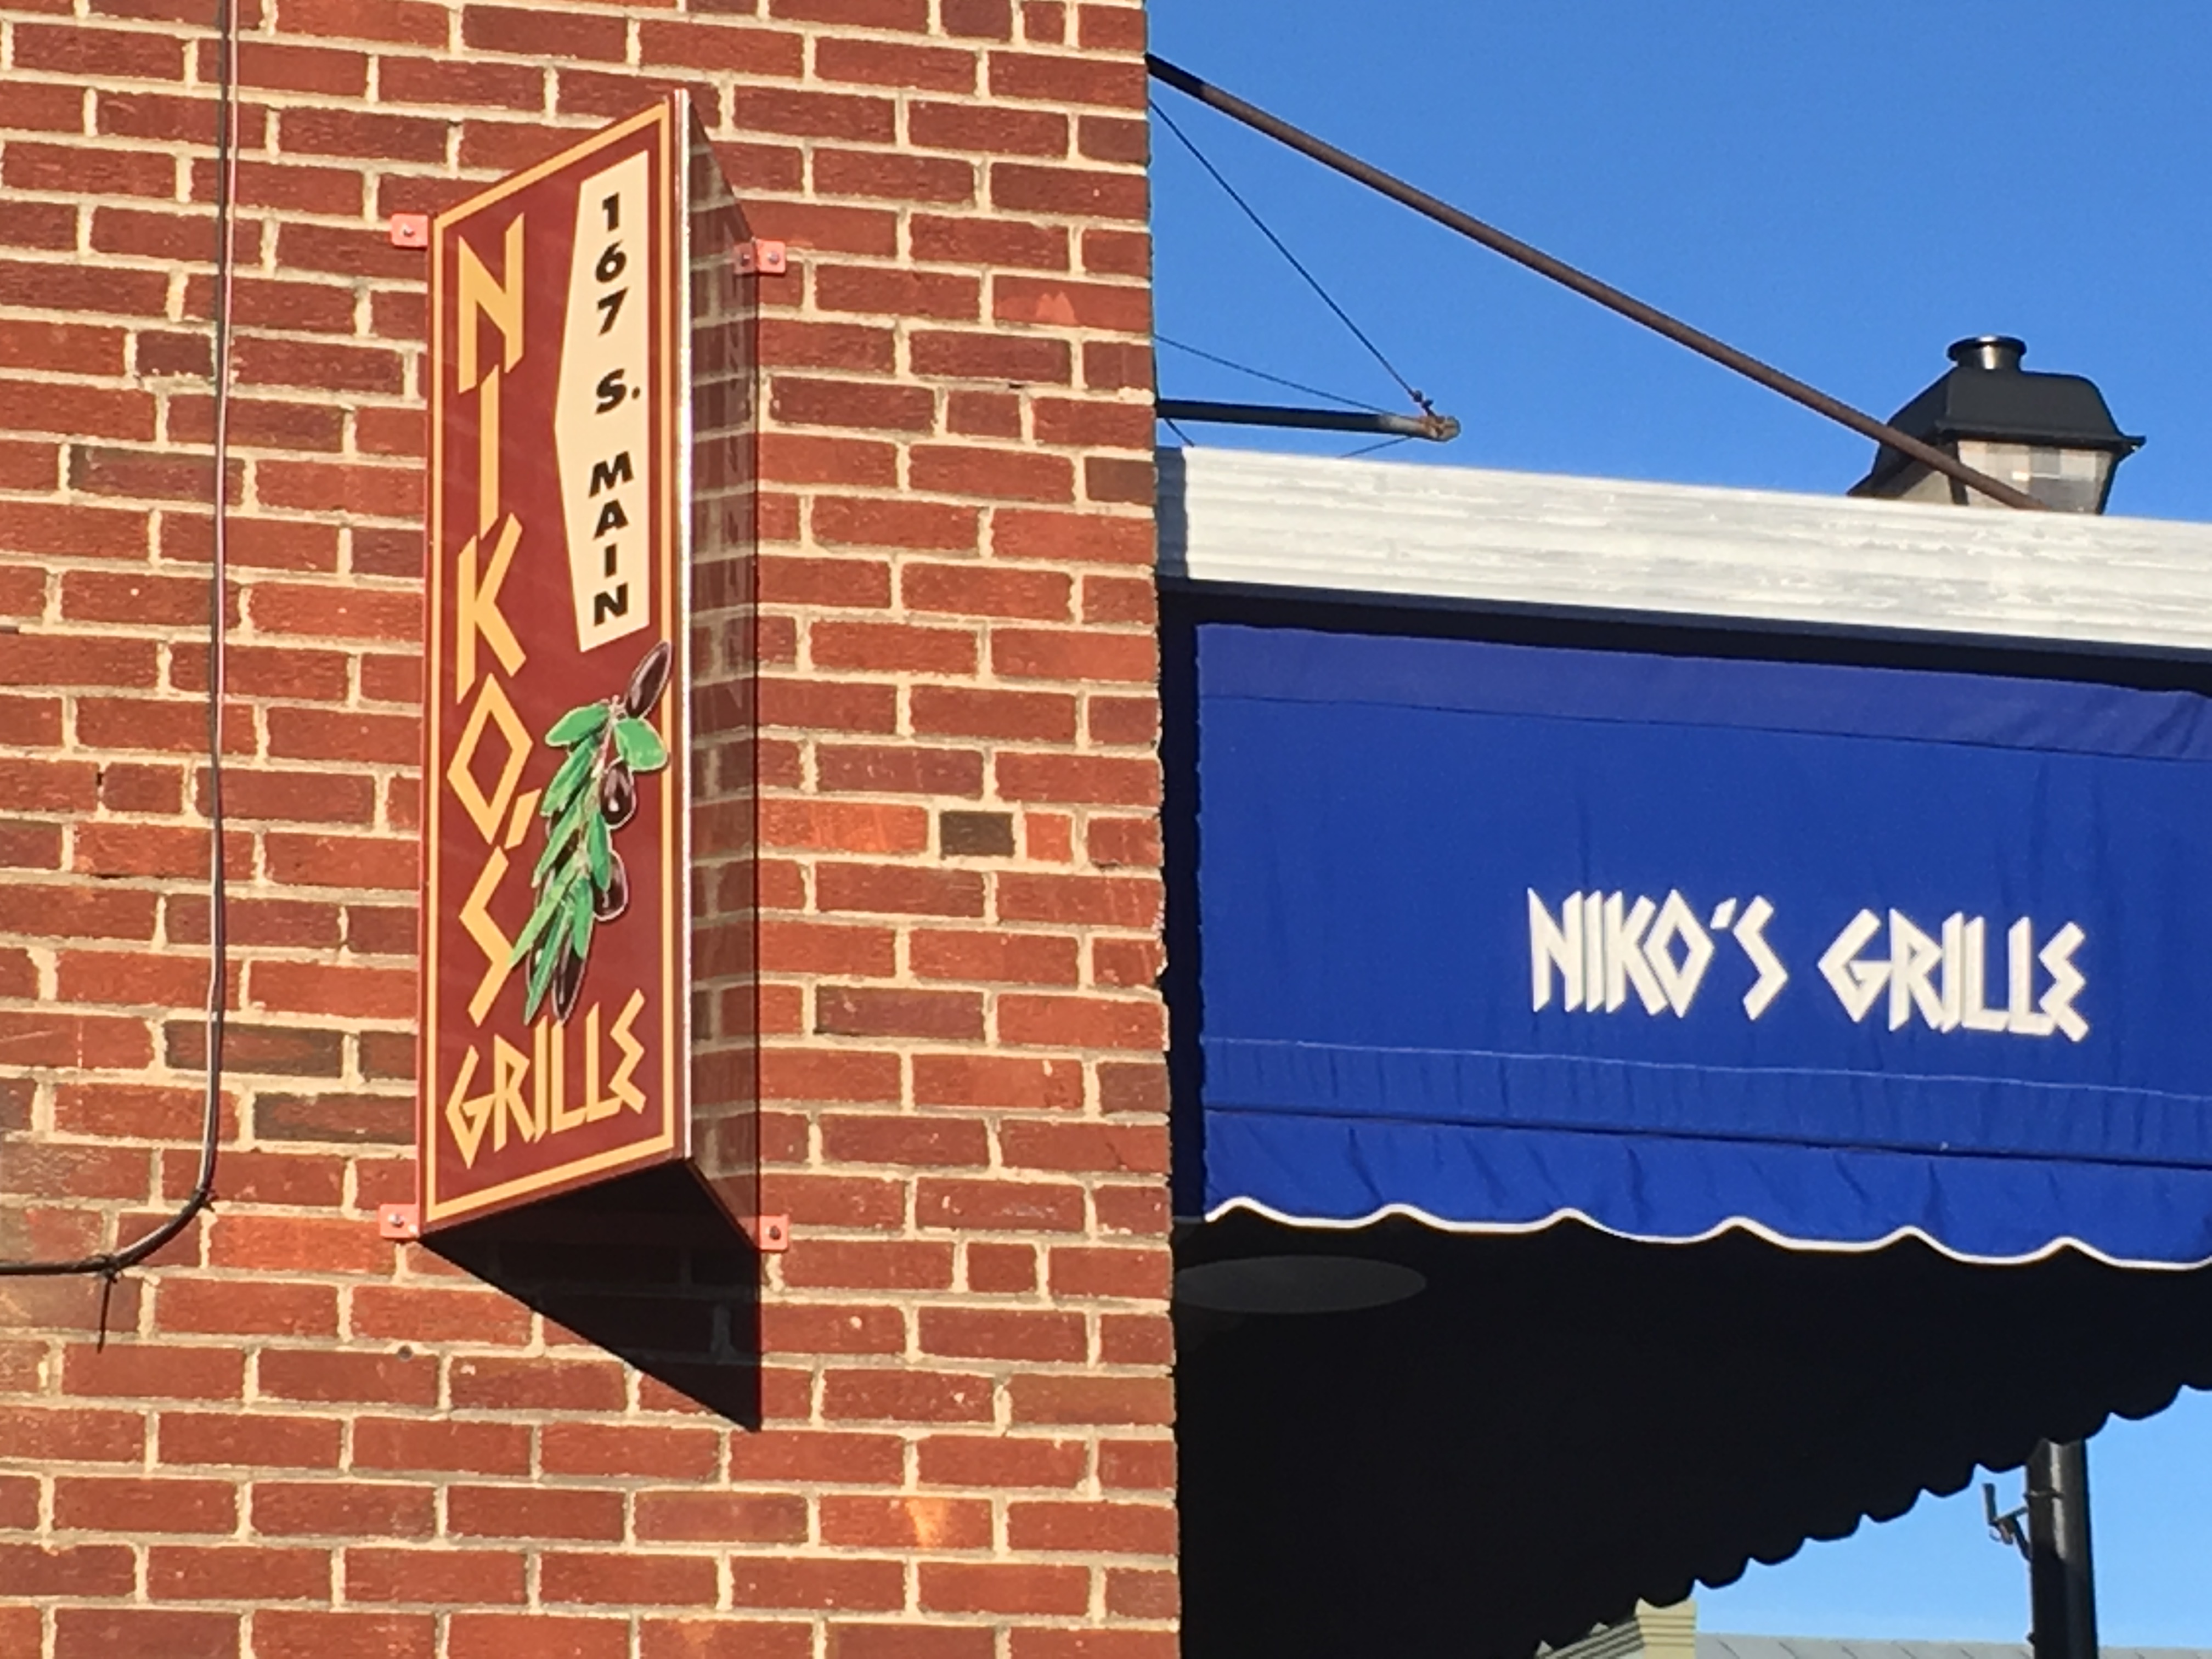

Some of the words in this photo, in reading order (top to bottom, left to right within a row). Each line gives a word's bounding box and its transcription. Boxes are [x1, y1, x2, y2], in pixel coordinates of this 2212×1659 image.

[595, 193, 628, 336] 167
[595, 368, 641, 414] S.
[447, 212, 540, 1026] NIKO'S
[589, 452, 634, 627] MAIN
[1527, 887, 1788, 1019] NIKO'S
[1818, 909, 2089, 1042] GRILLE
[445, 989, 646, 1169] GRILLE
